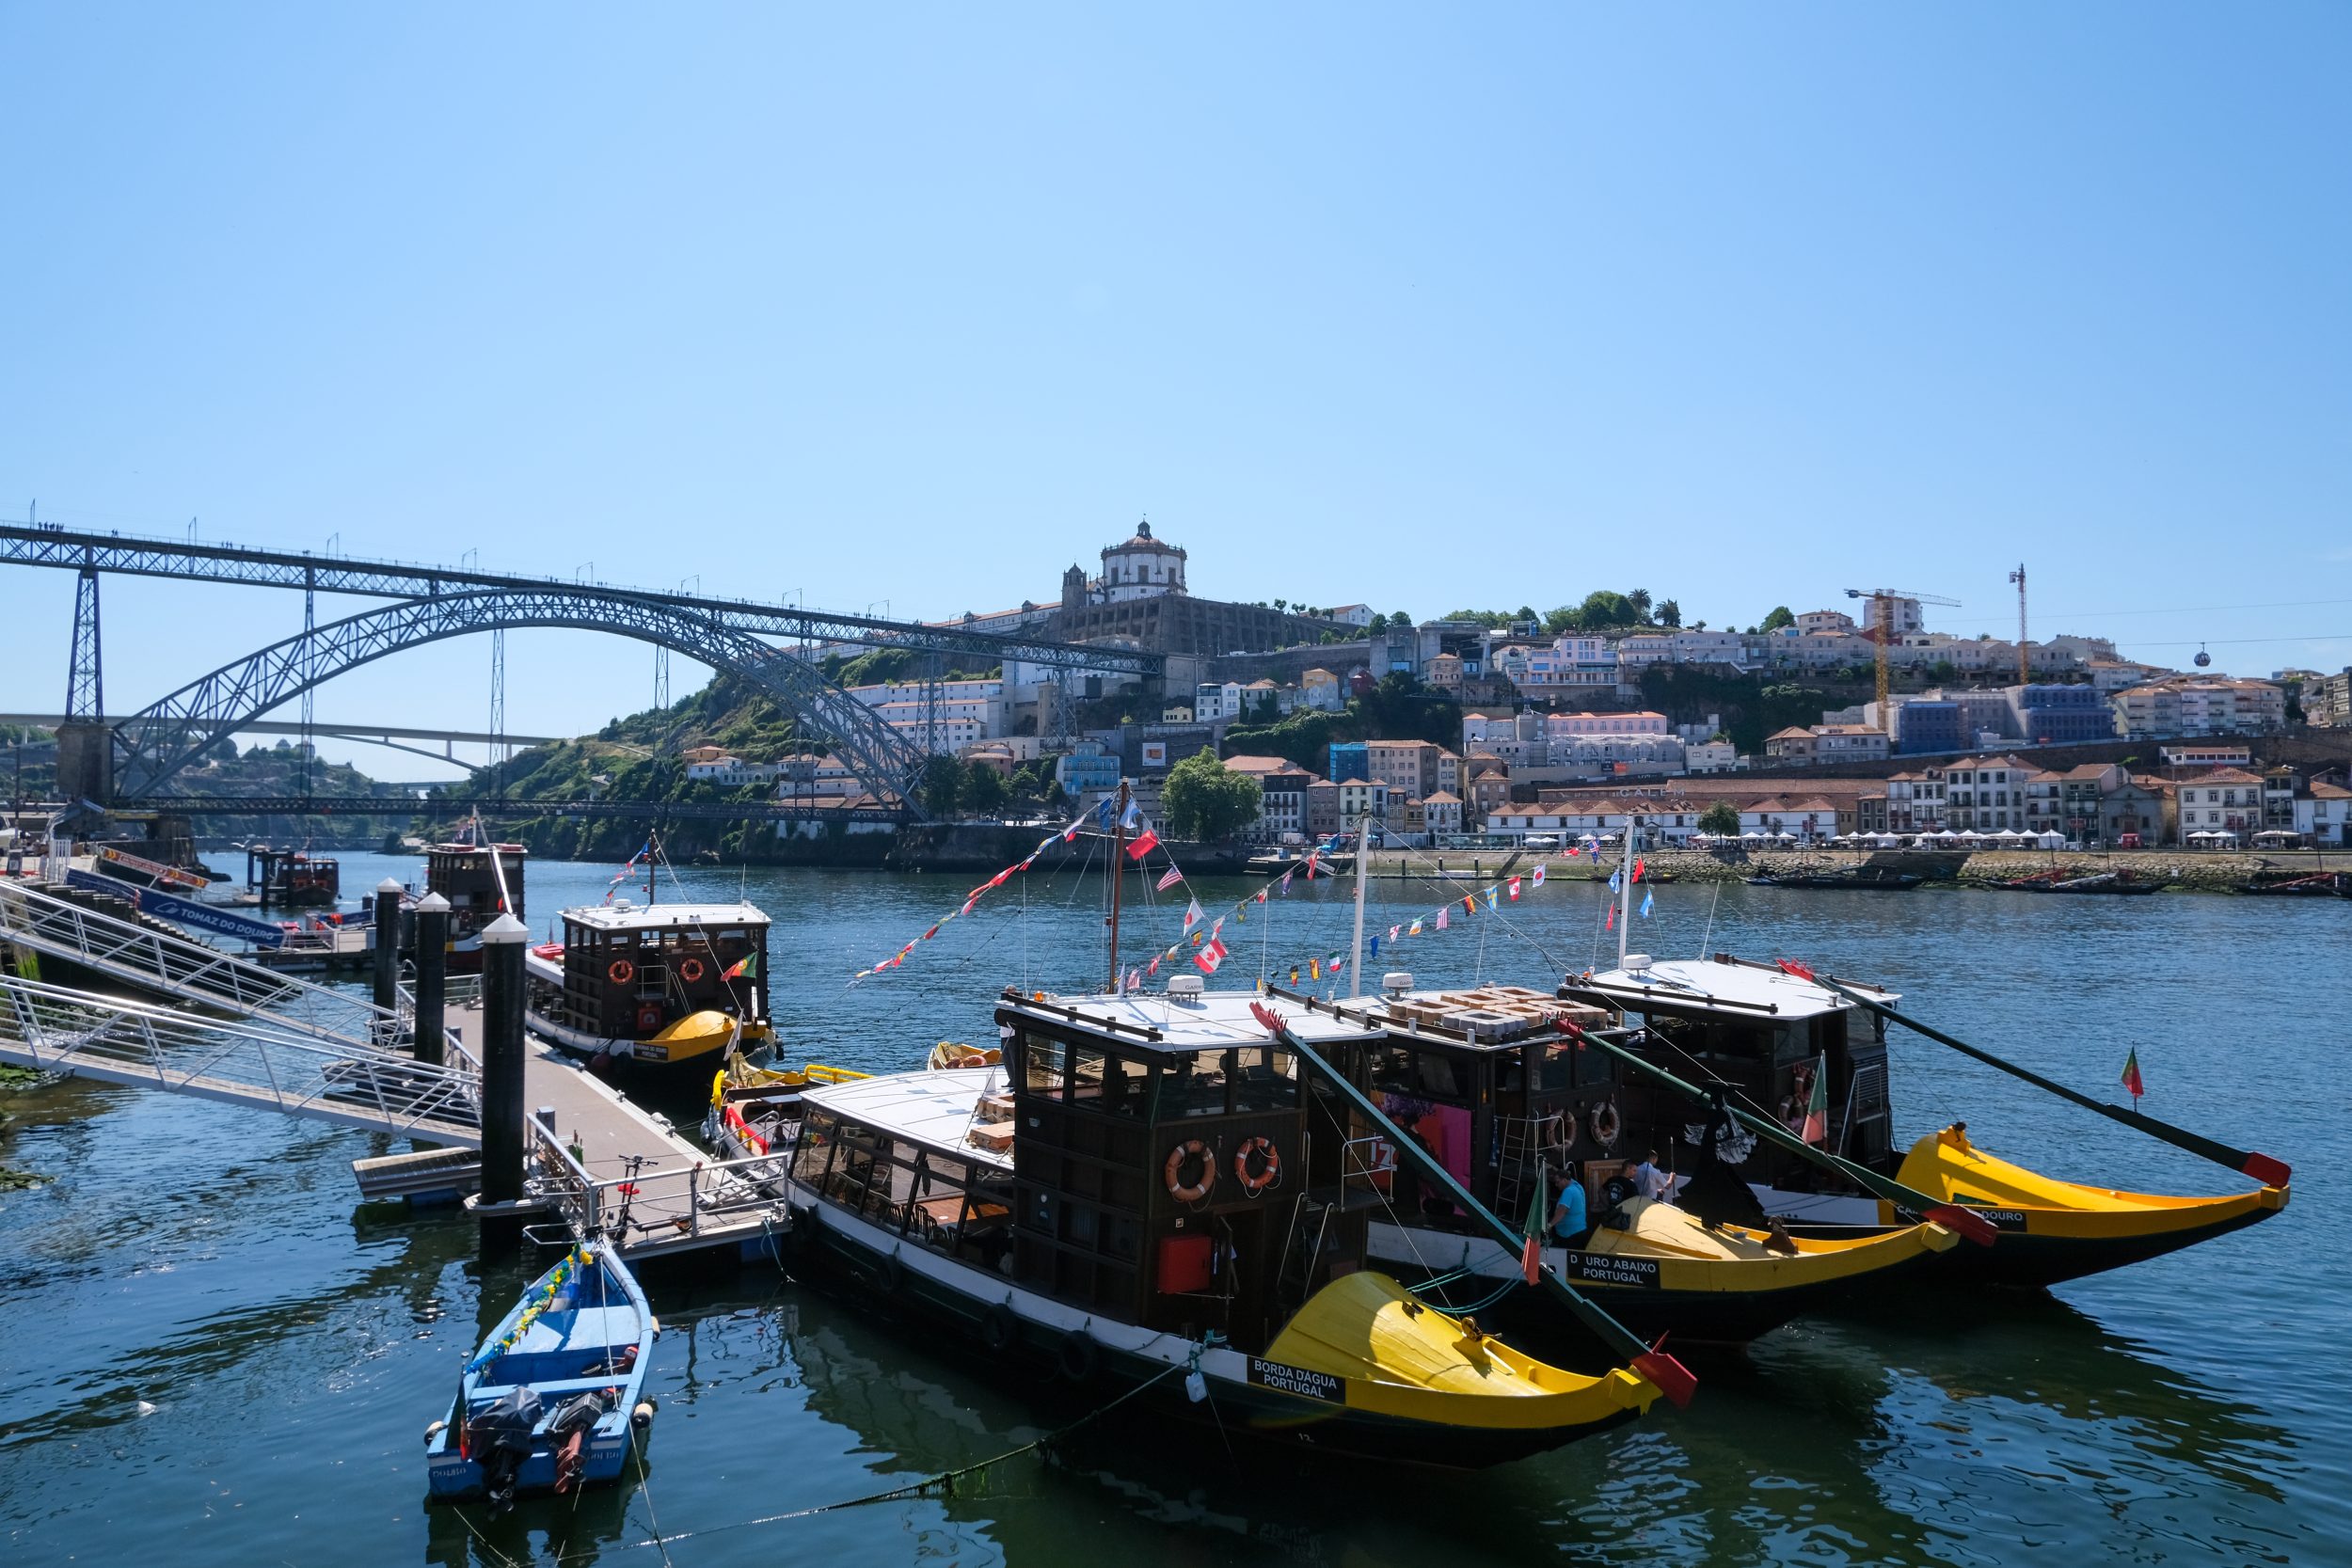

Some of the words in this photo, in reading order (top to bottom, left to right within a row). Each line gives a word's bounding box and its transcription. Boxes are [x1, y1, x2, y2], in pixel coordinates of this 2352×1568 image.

[181, 908, 219, 926] TOMAZ
[219, 919, 235, 930] DO
[236, 924, 275, 941] DOURO
[1981, 1210, 2024, 1222] DOURO
[1582, 1267, 1644, 1284] PORTUGAL
[1613, 1259, 1657, 1274] ABAIXO
[1254, 1359, 1294, 1379] BORDA
[1263, 1373, 1326, 1399] PORTUGAL
